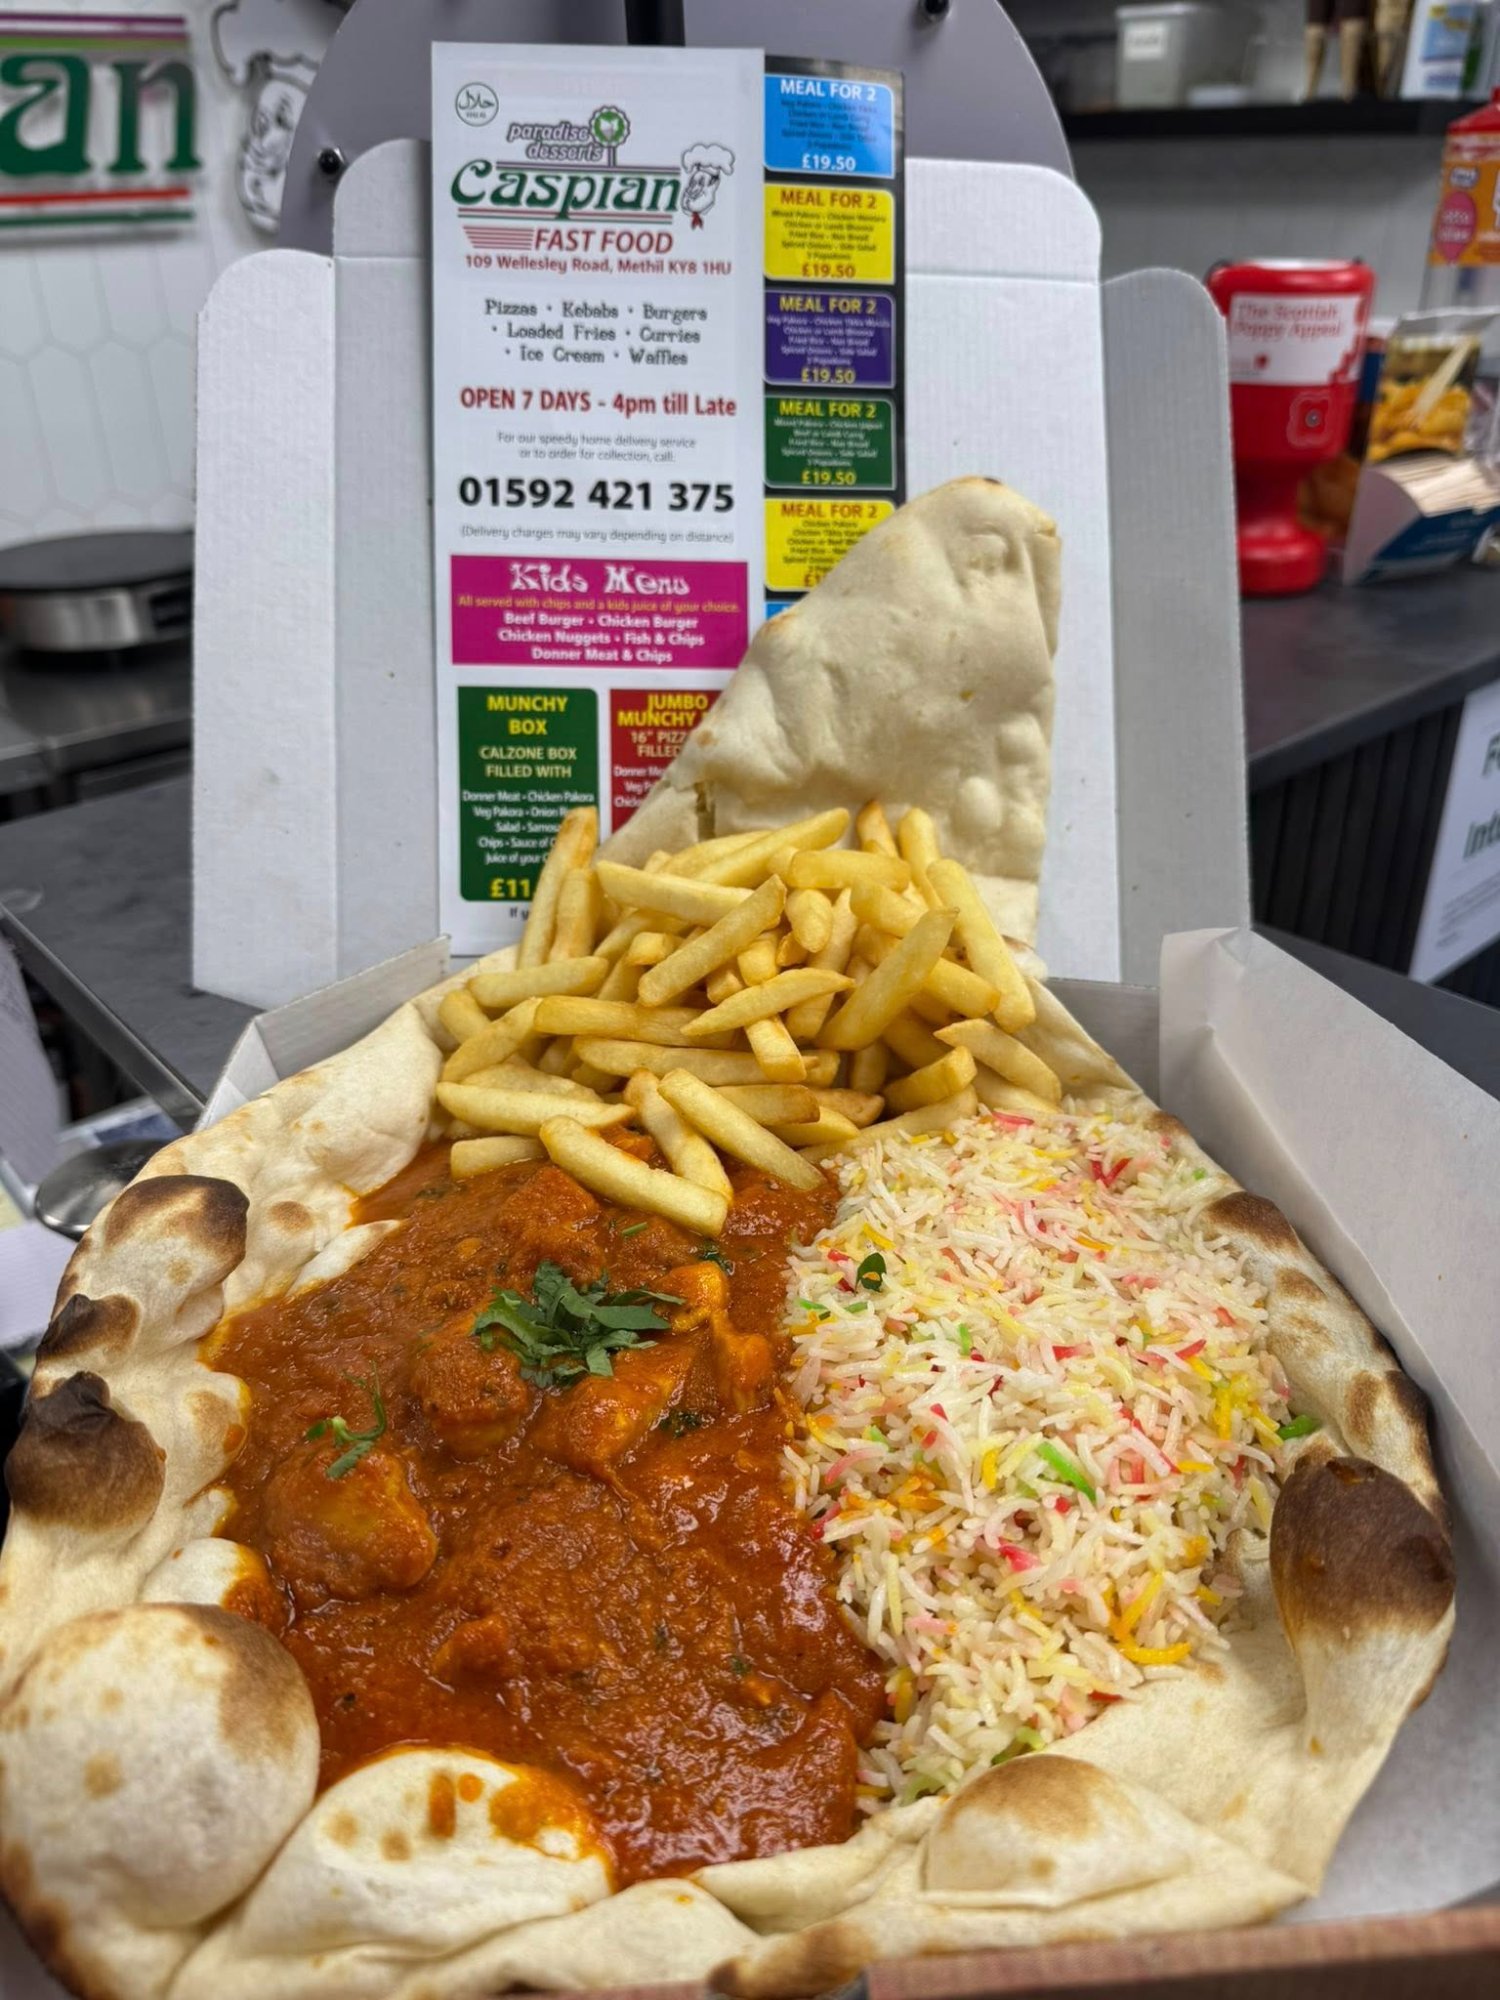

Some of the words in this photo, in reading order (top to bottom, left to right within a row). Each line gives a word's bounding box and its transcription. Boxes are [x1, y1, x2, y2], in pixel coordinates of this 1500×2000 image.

[780, 79, 825, 97] MEAL
[829, 82, 863, 99] FOR
[866, 87, 877, 101] 2
[507, 120, 591, 143] paradise
[525, 142, 602, 162] desserts
[801, 153, 857, 171] £19.50
[450, 159, 681, 219] Caspian
[780, 190, 825, 207] MEAL
[829, 192, 863, 208] FOR
[867, 195, 877, 209] 2
[535, 229, 595, 251] FAST
[601, 231, 673, 253] FOOD
[466, 255, 492, 269] 109
[497, 255, 567, 274] Wellesley
[571, 258, 613, 274] Road,
[617, 259, 664, 274] Methil
[668, 261, 697, 275] KY8
[702, 261, 732, 275] 1HU
[801, 263, 857, 279] £19.50
[484, 298, 538, 316] Pizzas
[562, 301, 619, 319] Kebabs
[642, 303, 708, 325] Burgers
[780, 295, 825, 312] MEAL
[829, 296, 863, 314] FOR
[865, 298, 877, 315] 2
[507, 322, 564, 340] Loaded
[574, 324, 616, 342] Fries
[639, 326, 702, 344] Curries
[519, 345, 544, 361] Ice
[552, 346, 605, 364] Cream
[629, 348, 689, 366] Waffles
[801, 367, 857, 385] £19.50
[460, 387, 516, 410] OPEN
[521, 390, 534, 411] 7
[539, 390, 592, 412] DAYS
[613, 393, 657, 418] 4pm
[662, 393, 689, 415] till
[694, 395, 738, 417] Late
[779, 400, 825, 417] MEAL
[828, 401, 863, 418] FOR
[865, 403, 877, 420] 2
[539, 432, 579, 448] speedy
[581, 434, 612, 446] home
[614, 434, 658, 450] delivery
[660, 438, 697, 449] service
[547, 448, 578, 459] order
[801, 469, 857, 486] £19.50
[459, 477, 574, 508] 01592
[587, 480, 653, 511] 421
[668, 483, 735, 513] 375
[780, 502, 826, 519] MEAL
[829, 503, 864, 519] FOR
[867, 505, 879, 519] 2
[512, 526, 555, 540] charges
[556, 529, 582, 543] may
[609, 526, 668, 544] depending
[509, 562, 589, 593] Kids
[603, 564, 691, 595] Menu
[473, 596, 513, 608] served
[514, 597, 541, 609] with
[542, 598, 572, 611] chips
[607, 600, 630, 612] kids
[503, 610, 536, 625] Beef
[538, 612, 585, 629] Burger
[597, 613, 651, 629] Chicken
[653, 616, 699, 632] Burger
[498, 628, 552, 644] Chicken
[554, 630, 612, 647] Nuggets
[623, 631, 652, 645] Fish
[653, 632, 665, 646] &
[668, 632, 706, 649] Chips
[531, 646, 582, 661] Donner
[584, 648, 619, 662] Meat
[621, 649, 633, 662] &
[635, 649, 673, 665] Chips
[486, 694, 569, 713] MUNCHY
[647, 693, 709, 711] JUMBO
[507, 718, 548, 736] BOX
[617, 710, 697, 727] MUNCHY
[656, 732, 688, 745] PIZZ
[479, 746, 545, 760] CALZONE
[547, 747, 578, 761] BOX
[486, 764, 533, 778] FILLED
[536, 765, 573, 779] WITH
